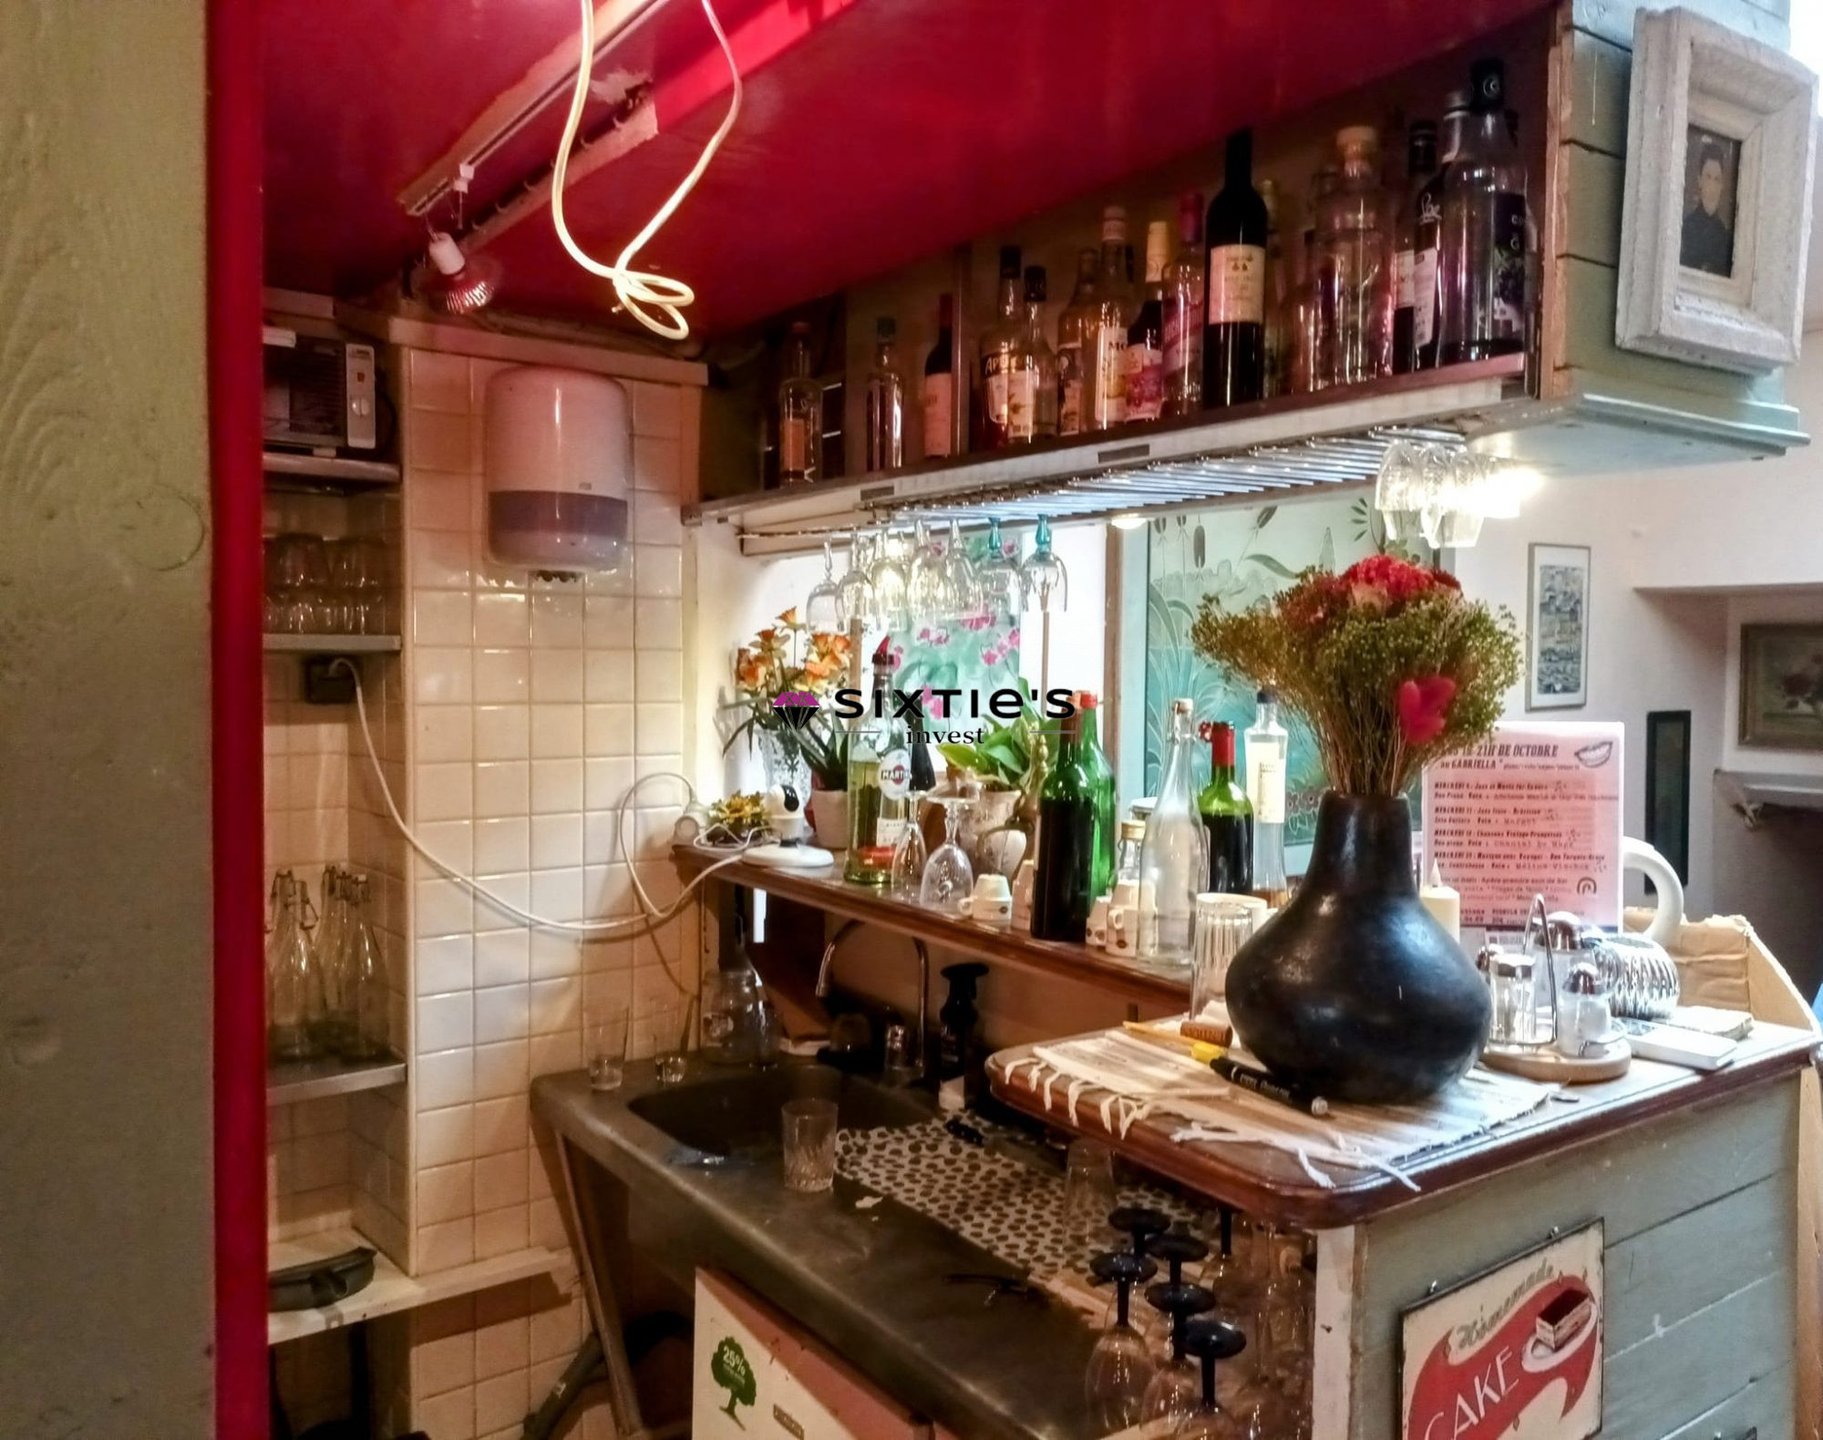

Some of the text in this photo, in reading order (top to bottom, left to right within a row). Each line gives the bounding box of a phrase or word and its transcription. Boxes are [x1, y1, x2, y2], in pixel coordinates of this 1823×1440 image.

[1498, 744, 1511, 757] DE
[1513, 744, 1559, 758] OCTOBRE
[1451, 759, 1497, 769] GABRIELLA
[881, 769, 910, 781] MARTI
[723, 1346, 746, 1377] 25%
[1424, 1346, 1519, 1440] CAKE
